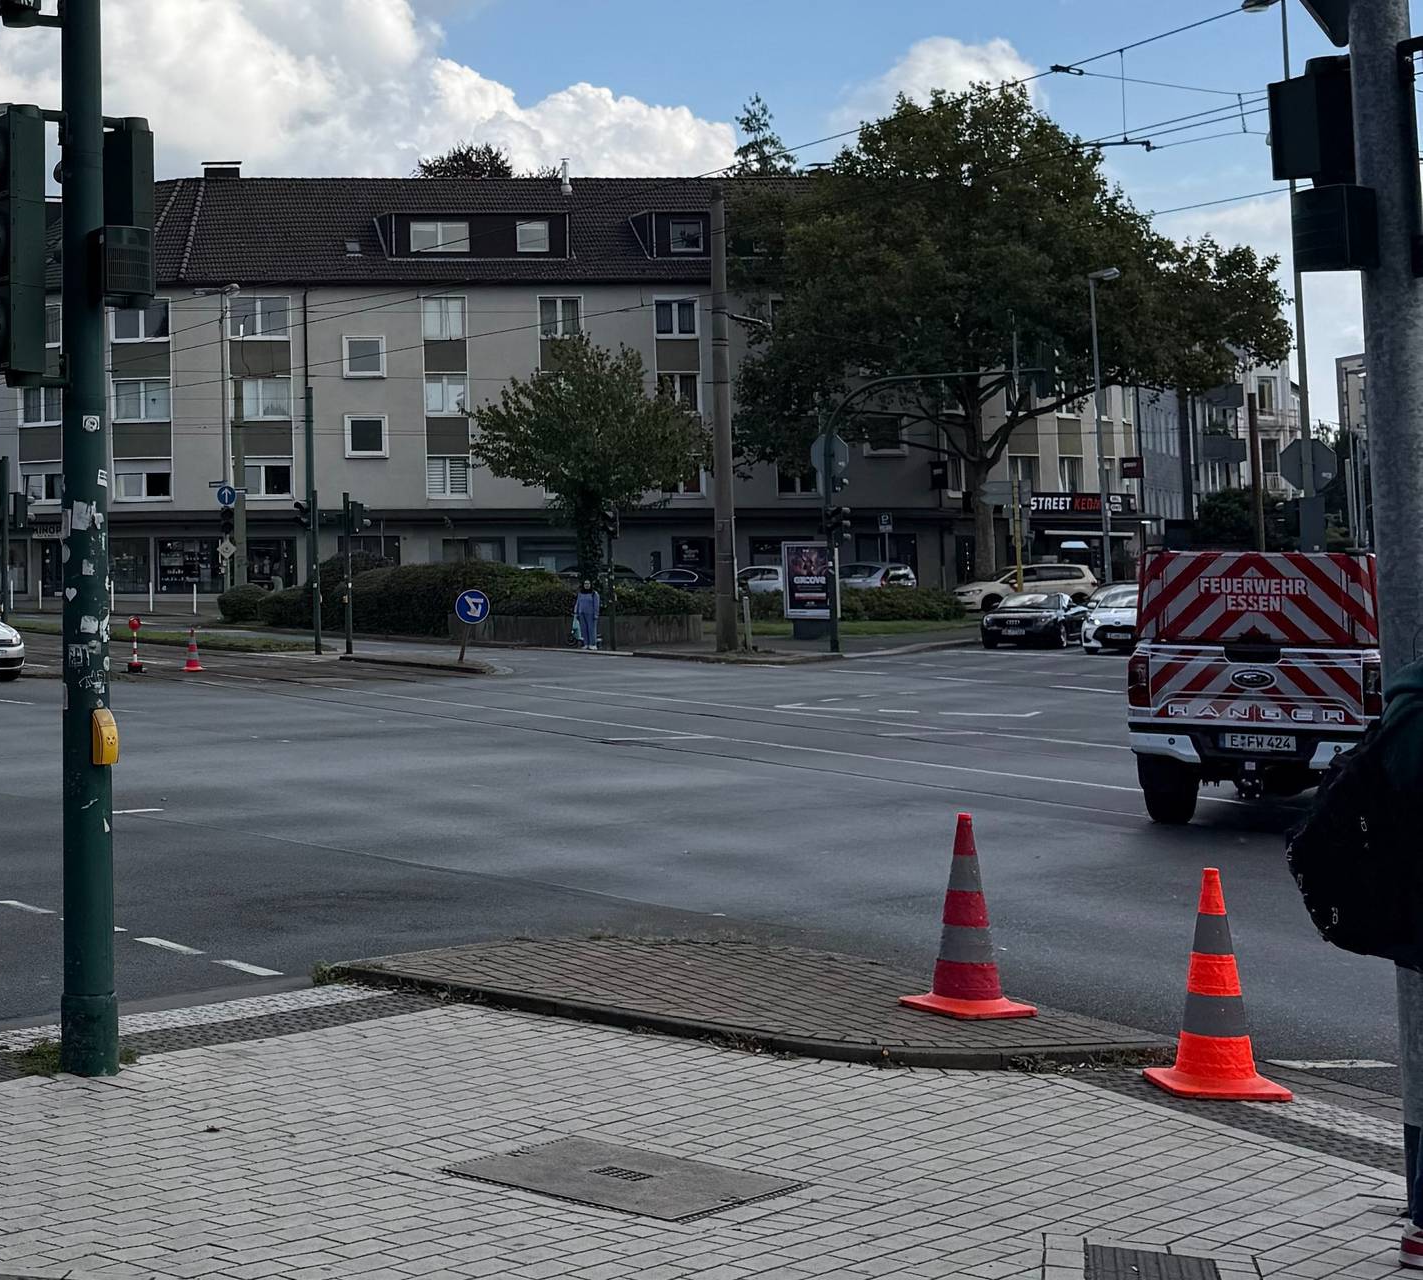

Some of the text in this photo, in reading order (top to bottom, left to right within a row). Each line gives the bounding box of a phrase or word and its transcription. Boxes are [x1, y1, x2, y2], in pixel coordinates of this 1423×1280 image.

[1030, 497, 1072, 511] STREET
[1199, 577, 1307, 595] FEUERWEHR
[1226, 595, 1282, 612] ESSEN
[1168, 704, 1345, 722] RANGER
[1267, 737, 1291, 749] 424
